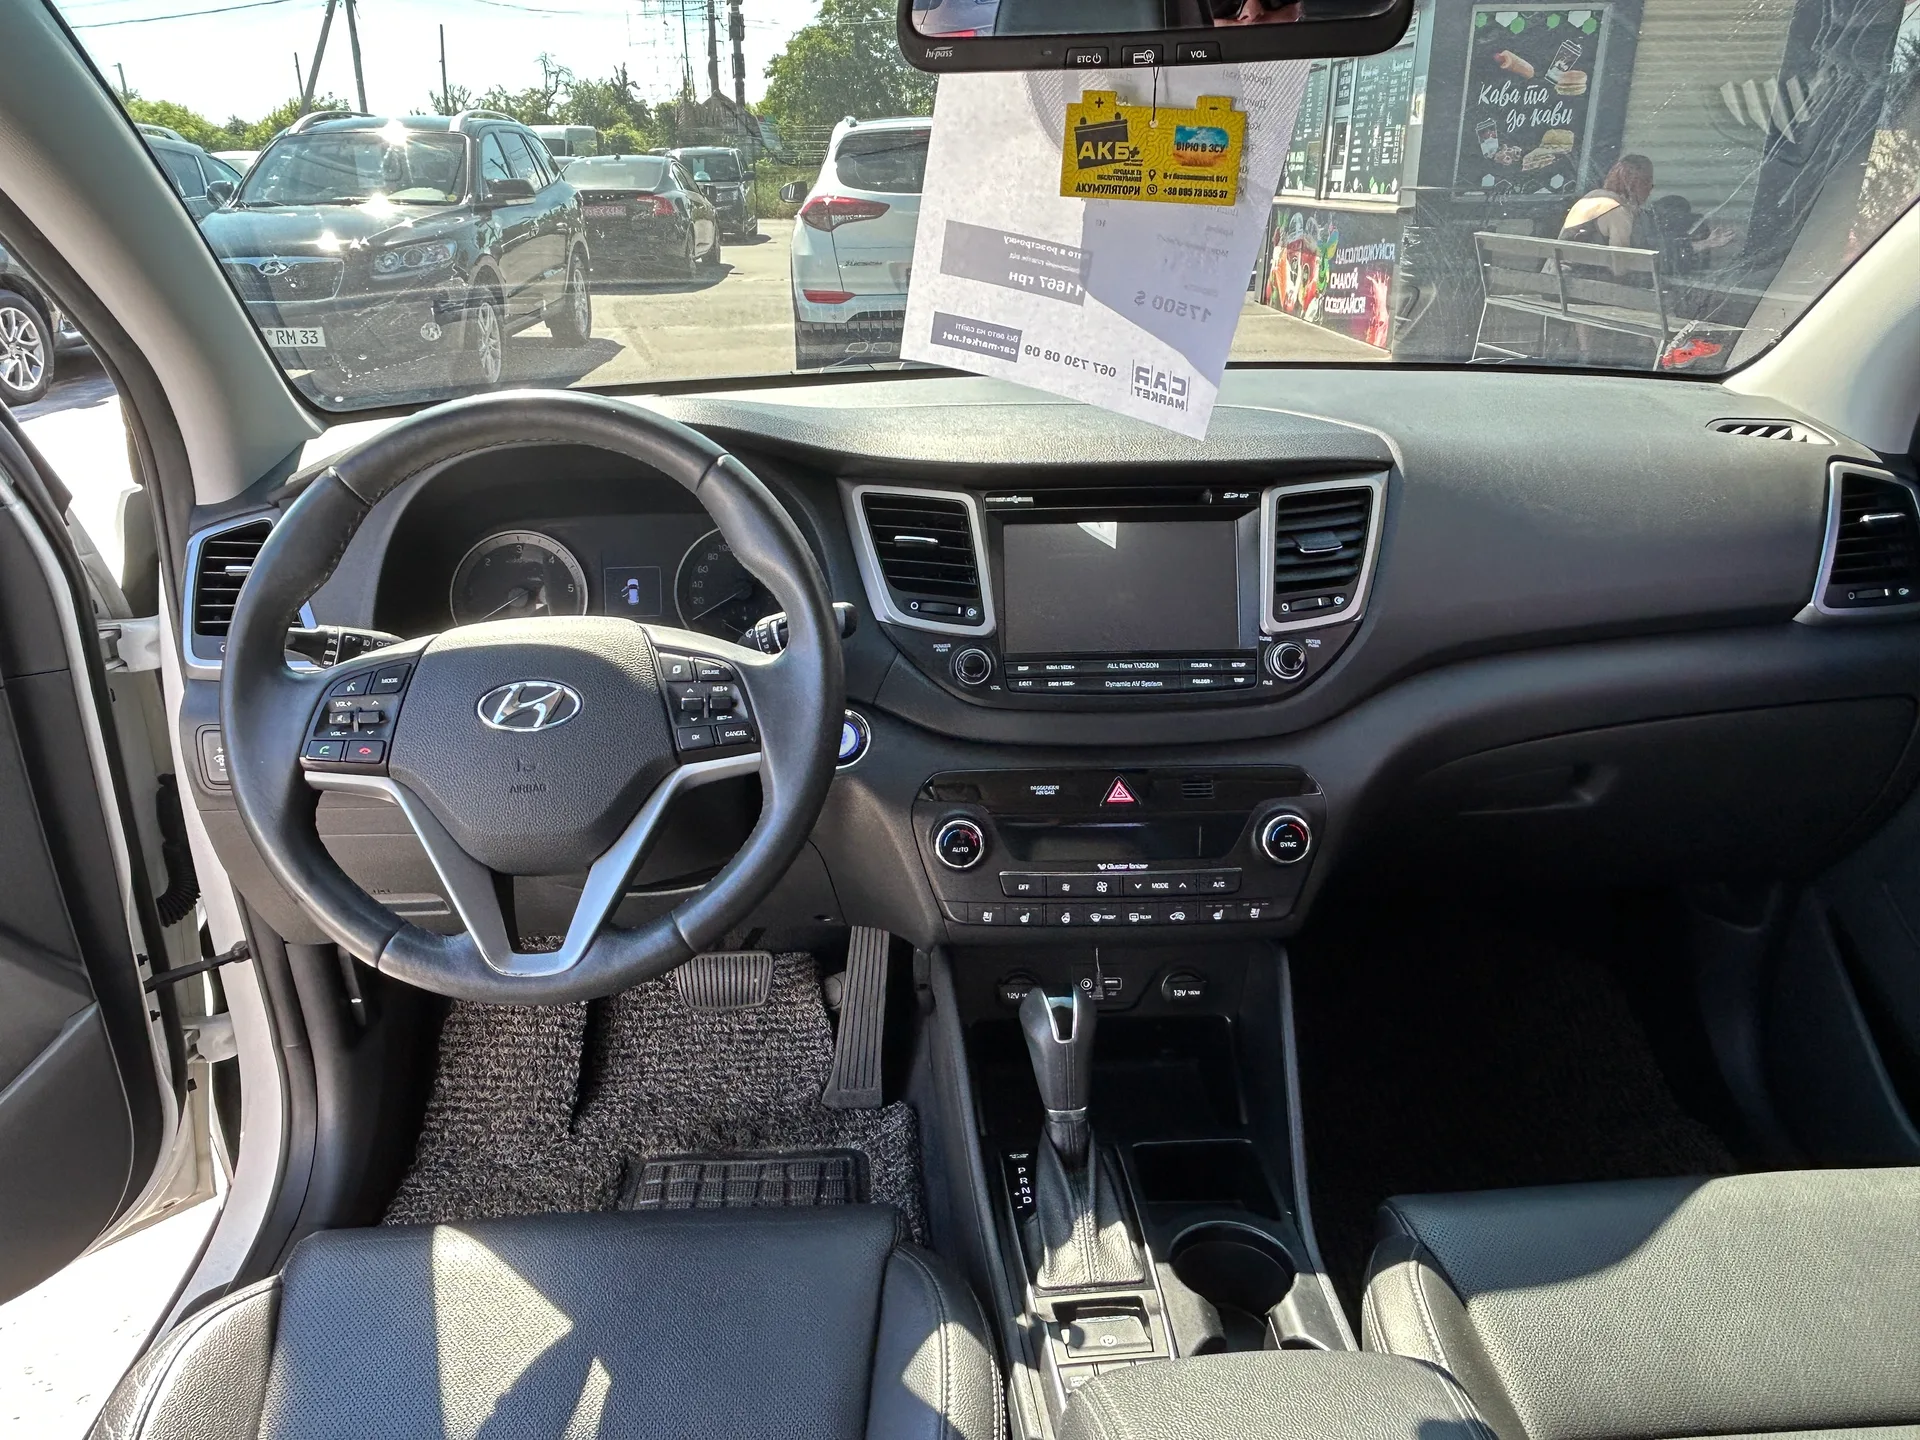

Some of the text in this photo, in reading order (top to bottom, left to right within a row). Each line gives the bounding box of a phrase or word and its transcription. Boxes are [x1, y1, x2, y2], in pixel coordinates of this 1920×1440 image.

[1076, 54, 1092, 64] ETC
[1190, 50, 1208, 59] VOL
[1478, 80, 1549, 107] Кава та
[1505, 101, 1573, 133] до кави
[1209, 143, 1226, 154] ЗСУ
[1076, 182, 1141, 196] АКУМУЛЯТОРИ
[276, 329, 319, 345] RM 33
[707, 553, 719, 561] 80
[567, 584, 574, 592] 5
[1023, 1196, 1032, 1204] D
